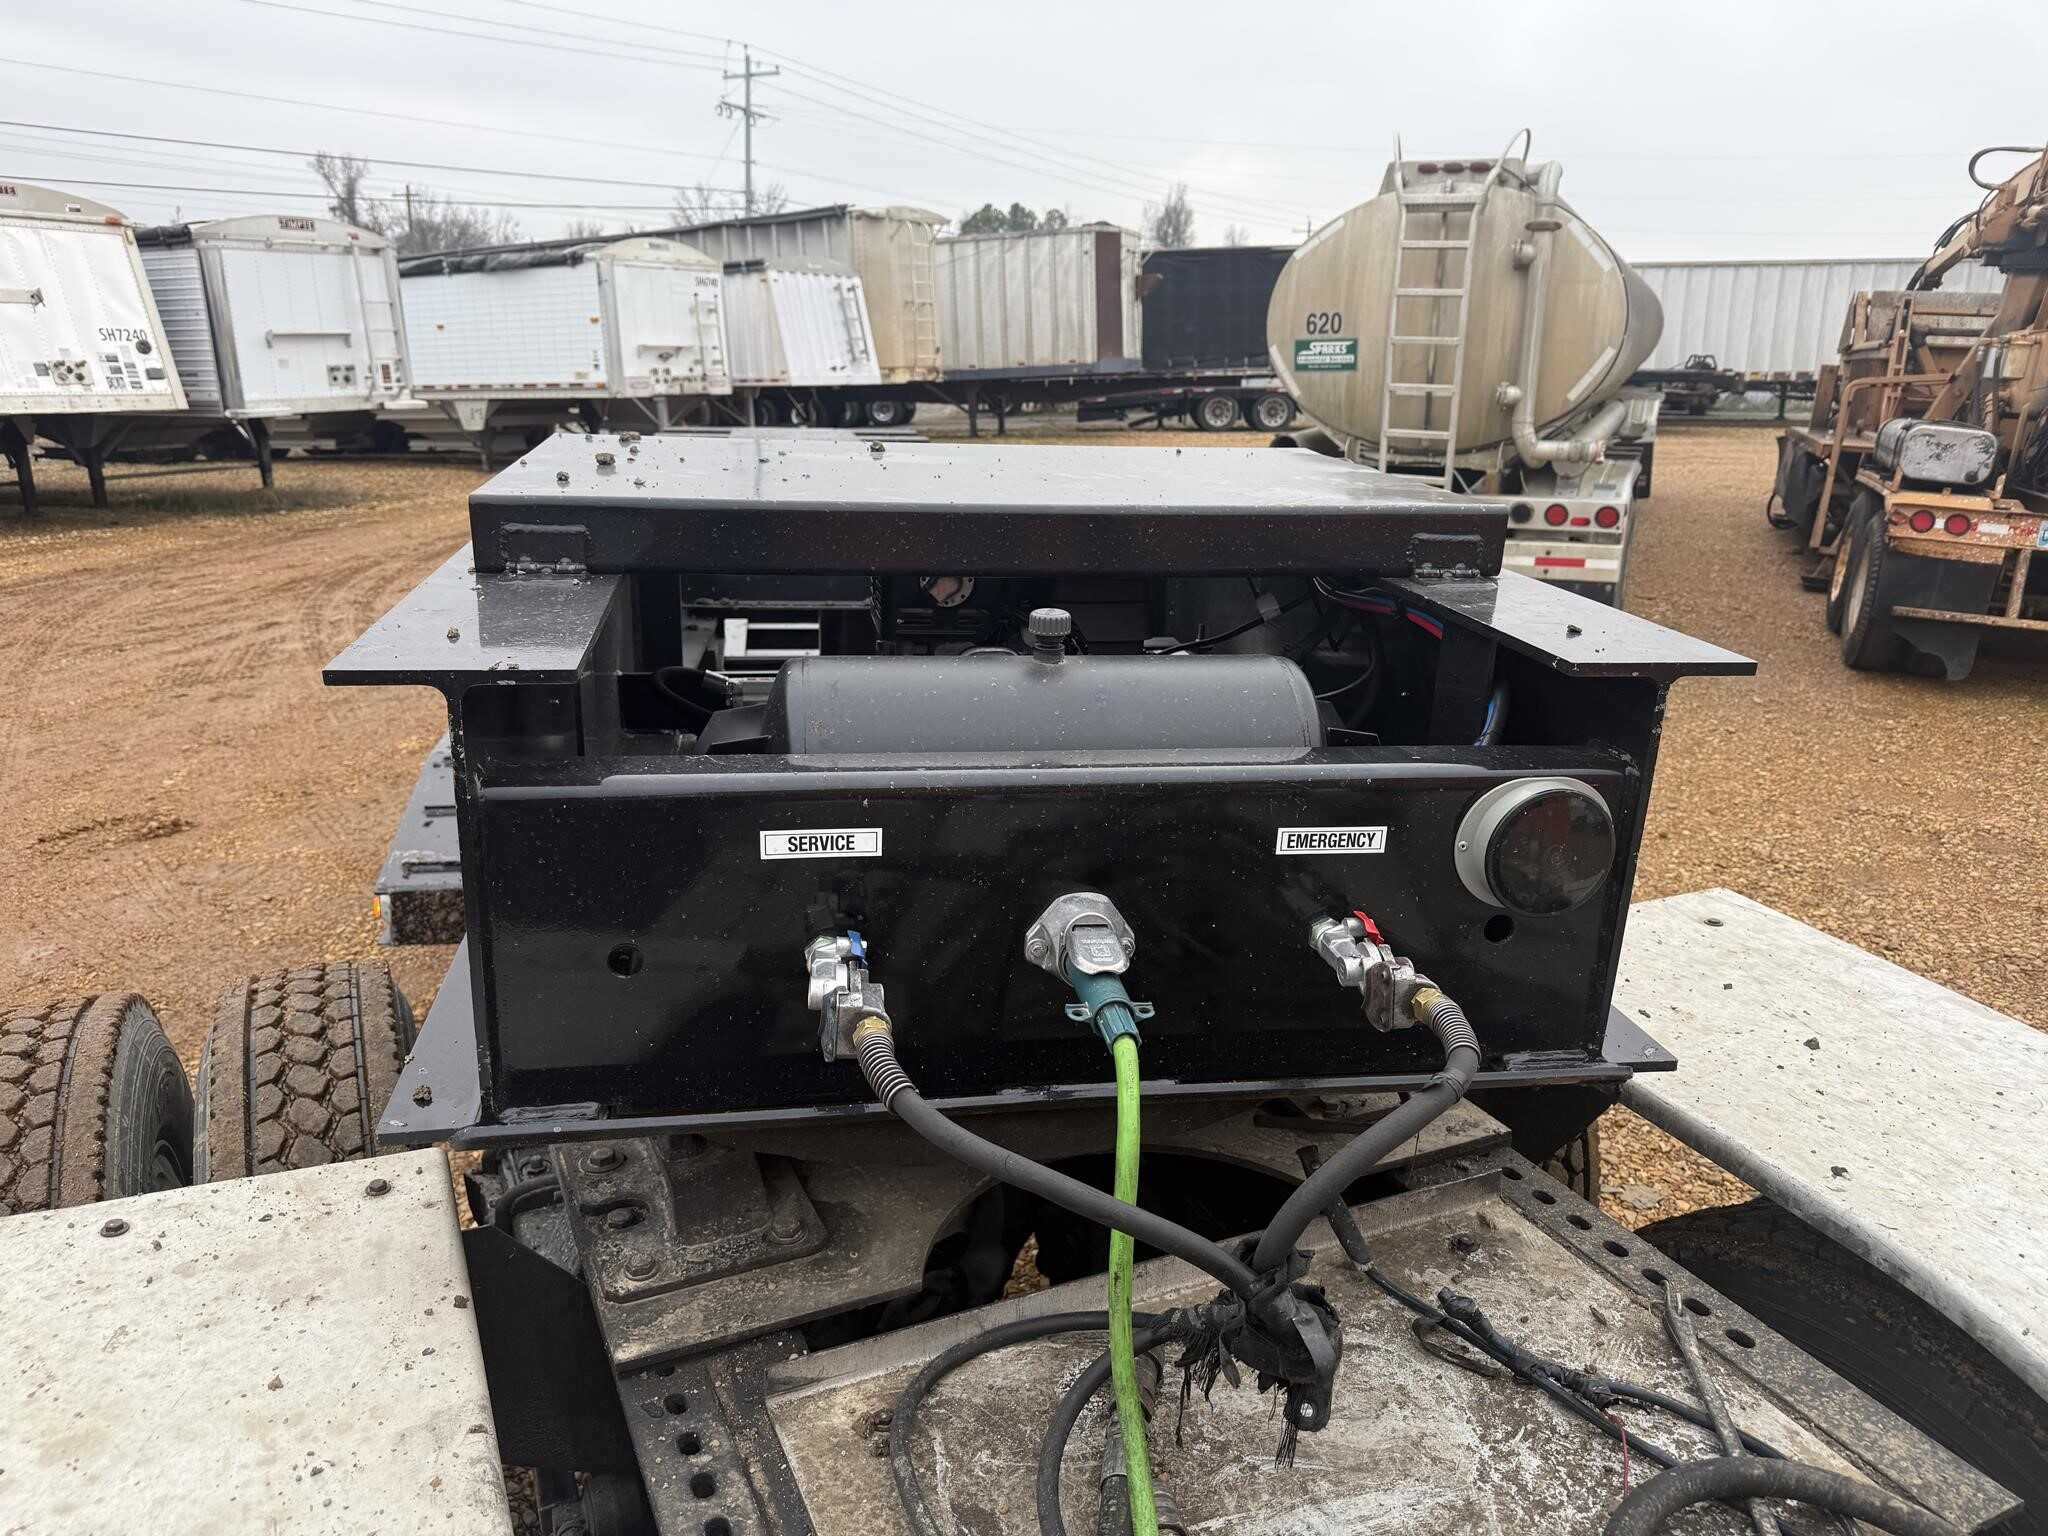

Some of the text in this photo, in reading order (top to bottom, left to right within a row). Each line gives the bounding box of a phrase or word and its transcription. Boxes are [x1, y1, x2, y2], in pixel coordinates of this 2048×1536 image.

[1306, 312, 1342, 335] 620
[98, 327, 148, 342] SH7240
[787, 834, 856, 853] SERVICE
[1286, 832, 1377, 849] EMERGENCY
